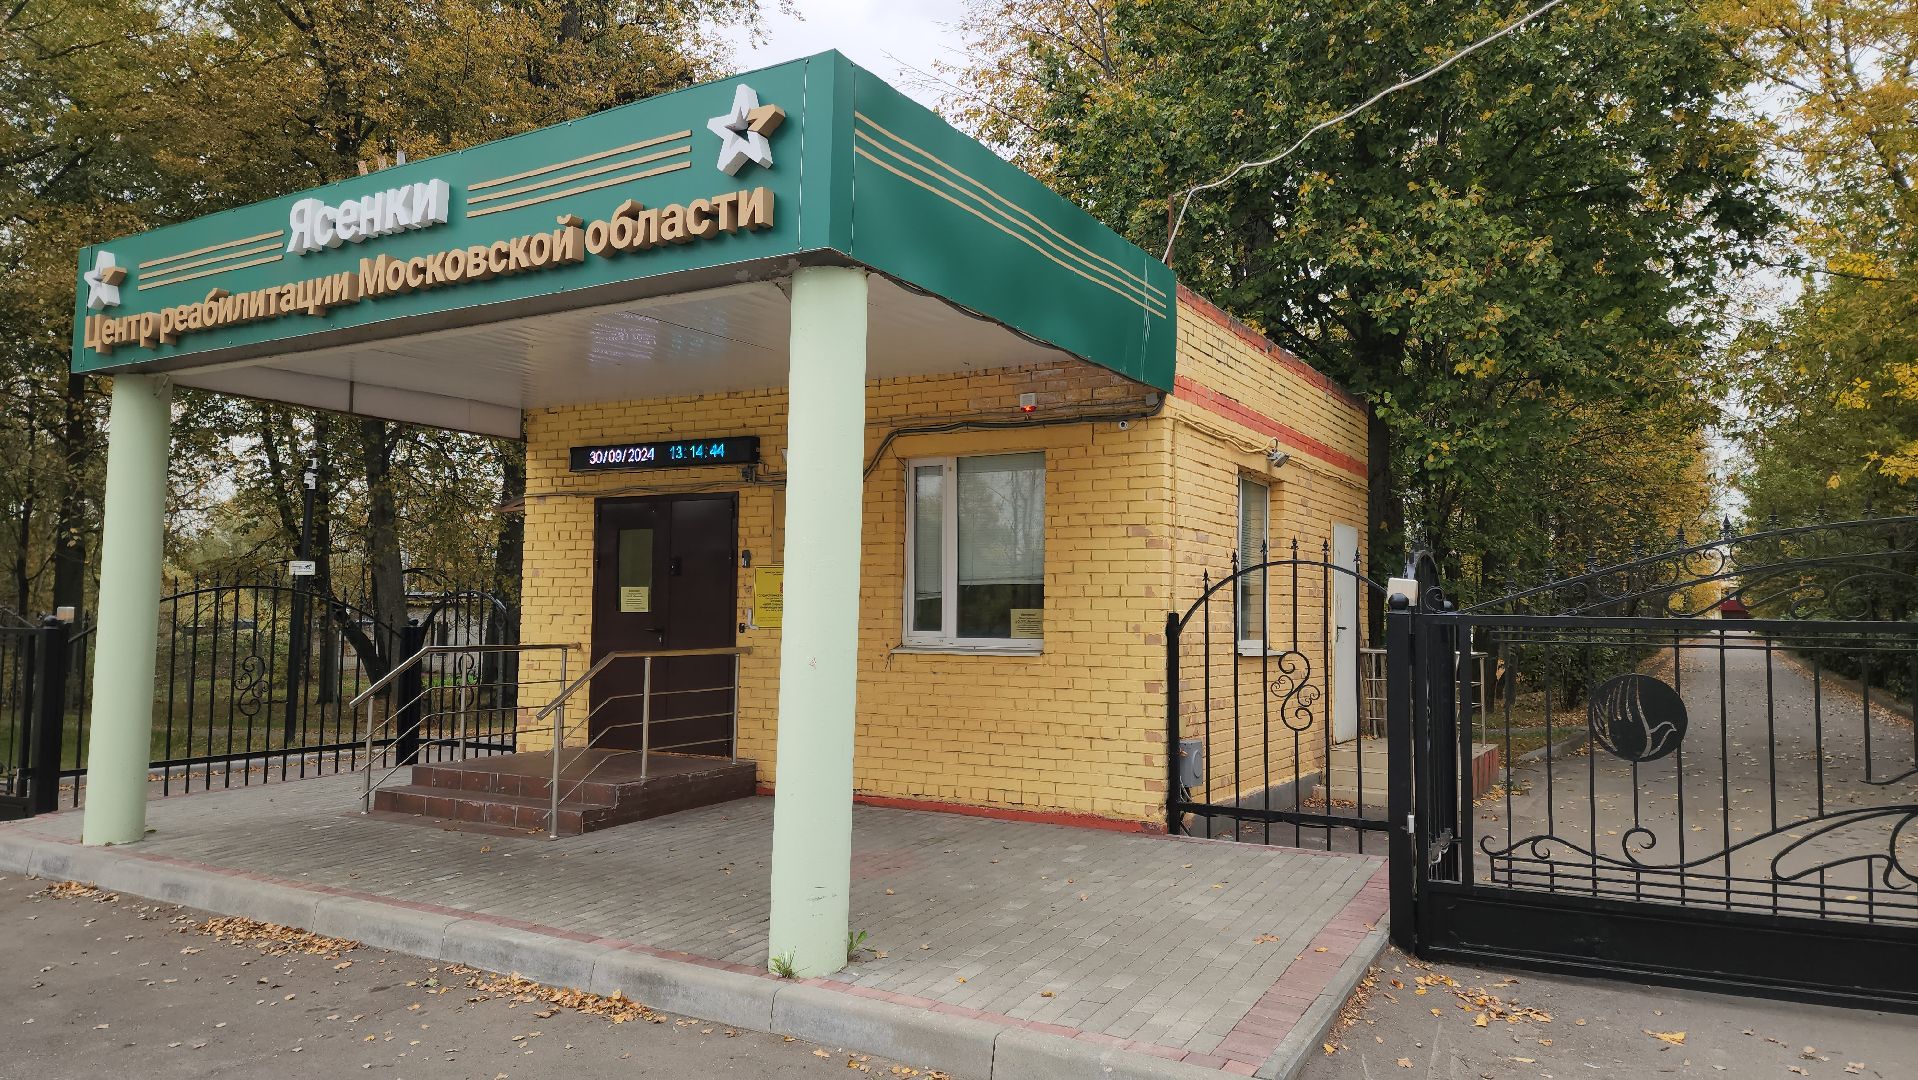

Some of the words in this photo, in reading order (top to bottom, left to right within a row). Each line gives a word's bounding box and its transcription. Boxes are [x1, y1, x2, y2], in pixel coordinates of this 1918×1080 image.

[286, 178, 450, 255] Ясенки
[84, 311, 161, 354] Центр
[159, 268, 360, 346] реабилитации
[358, 213, 584, 298] Московской
[585, 186, 775, 258] области
[589, 447, 655, 465] 30/09/2024
[669, 443, 725, 460] 13:14:44
